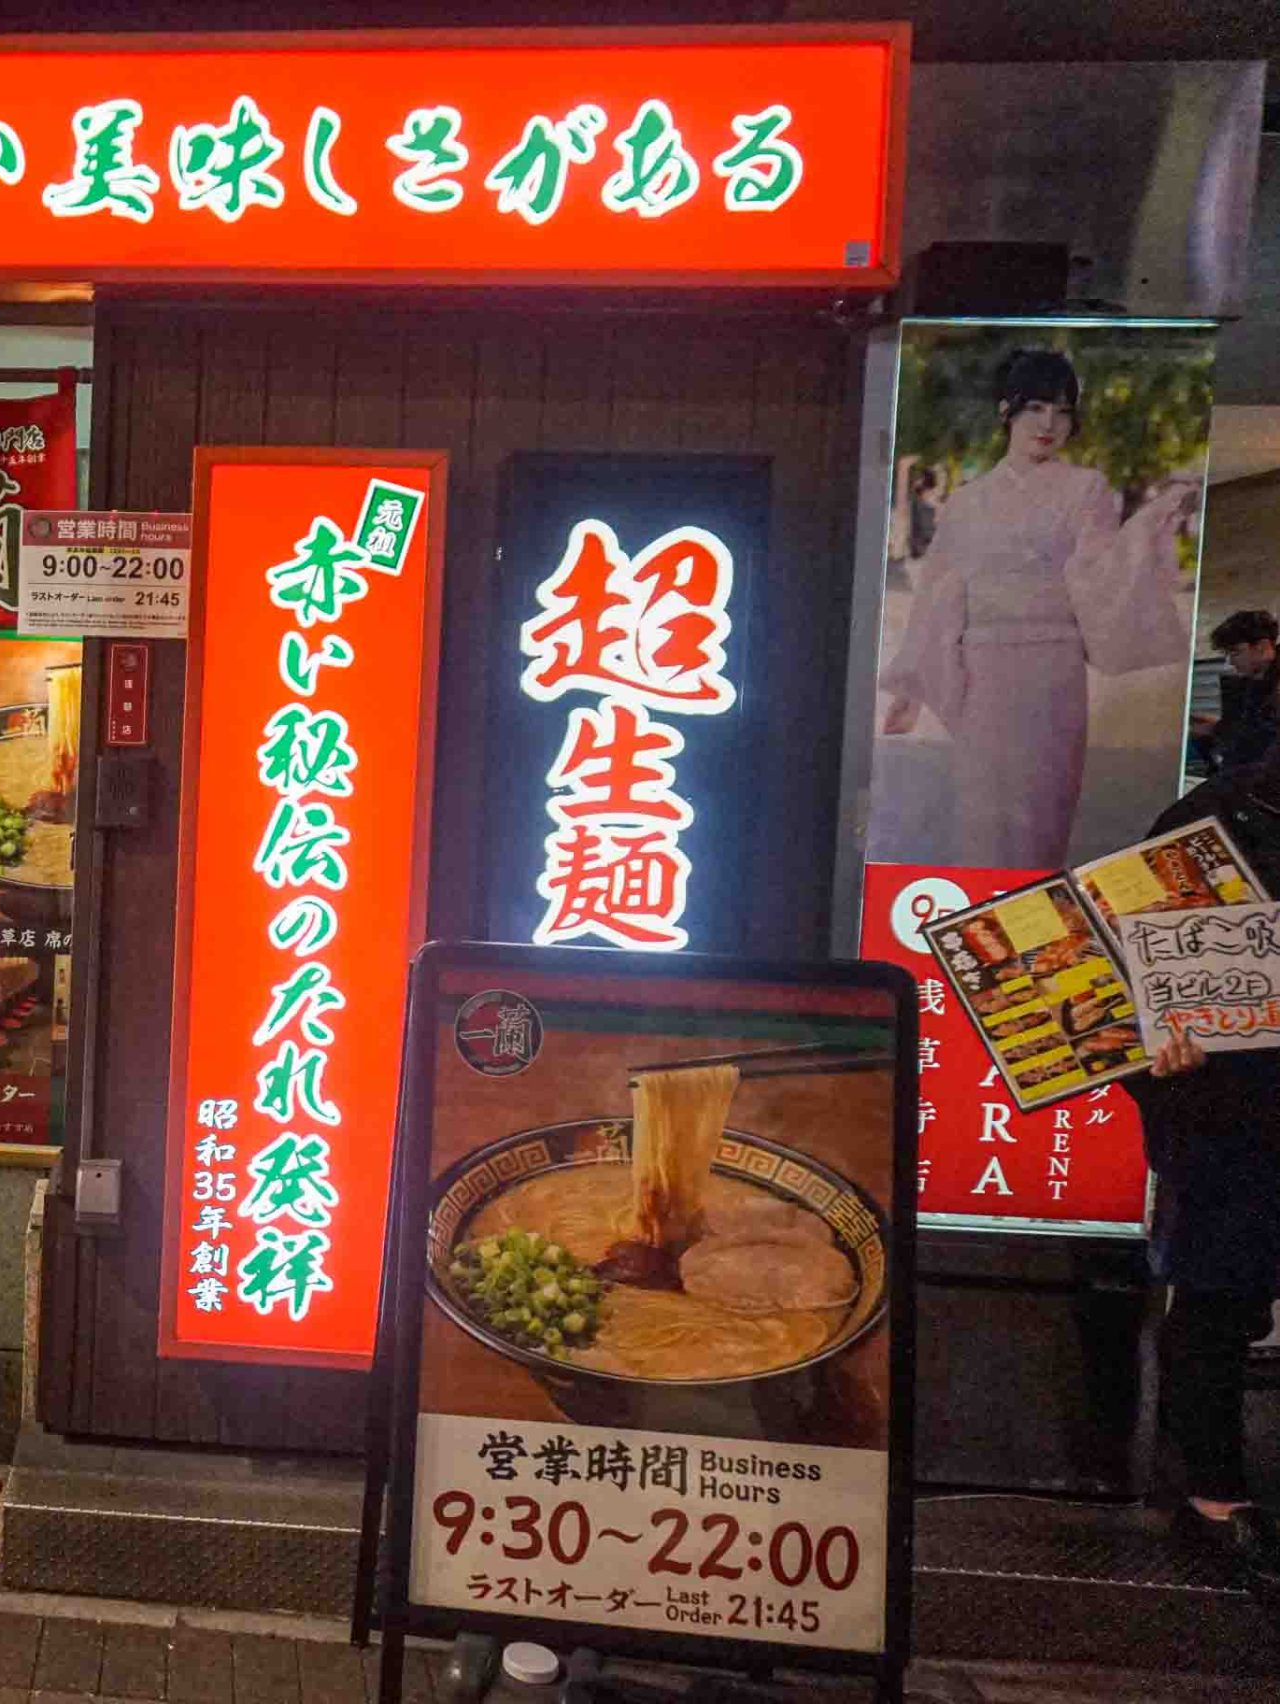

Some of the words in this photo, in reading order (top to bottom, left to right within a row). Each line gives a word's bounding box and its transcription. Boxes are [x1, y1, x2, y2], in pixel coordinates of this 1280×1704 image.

[57, 519, 138, 541] 営業時間
[141, 521, 189, 532] Business
[366, 497, 407, 558] 元祖
[31, 591, 85, 602] ラストオーダー
[135, 591, 181, 607] 21:45
[187, 1098, 239, 1312] 昭和35年創業
[478, 1430, 689, 1497] 営業時間
[699, 1449, 822, 1481] Business
[699, 1477, 782, 1505] Hours
[466, 1573, 663, 1613] ラストオーダー
[665, 1586, 711, 1605] Last
[726, 1594, 820, 1633] 21:45
[665, 1603, 723, 1626] Order
